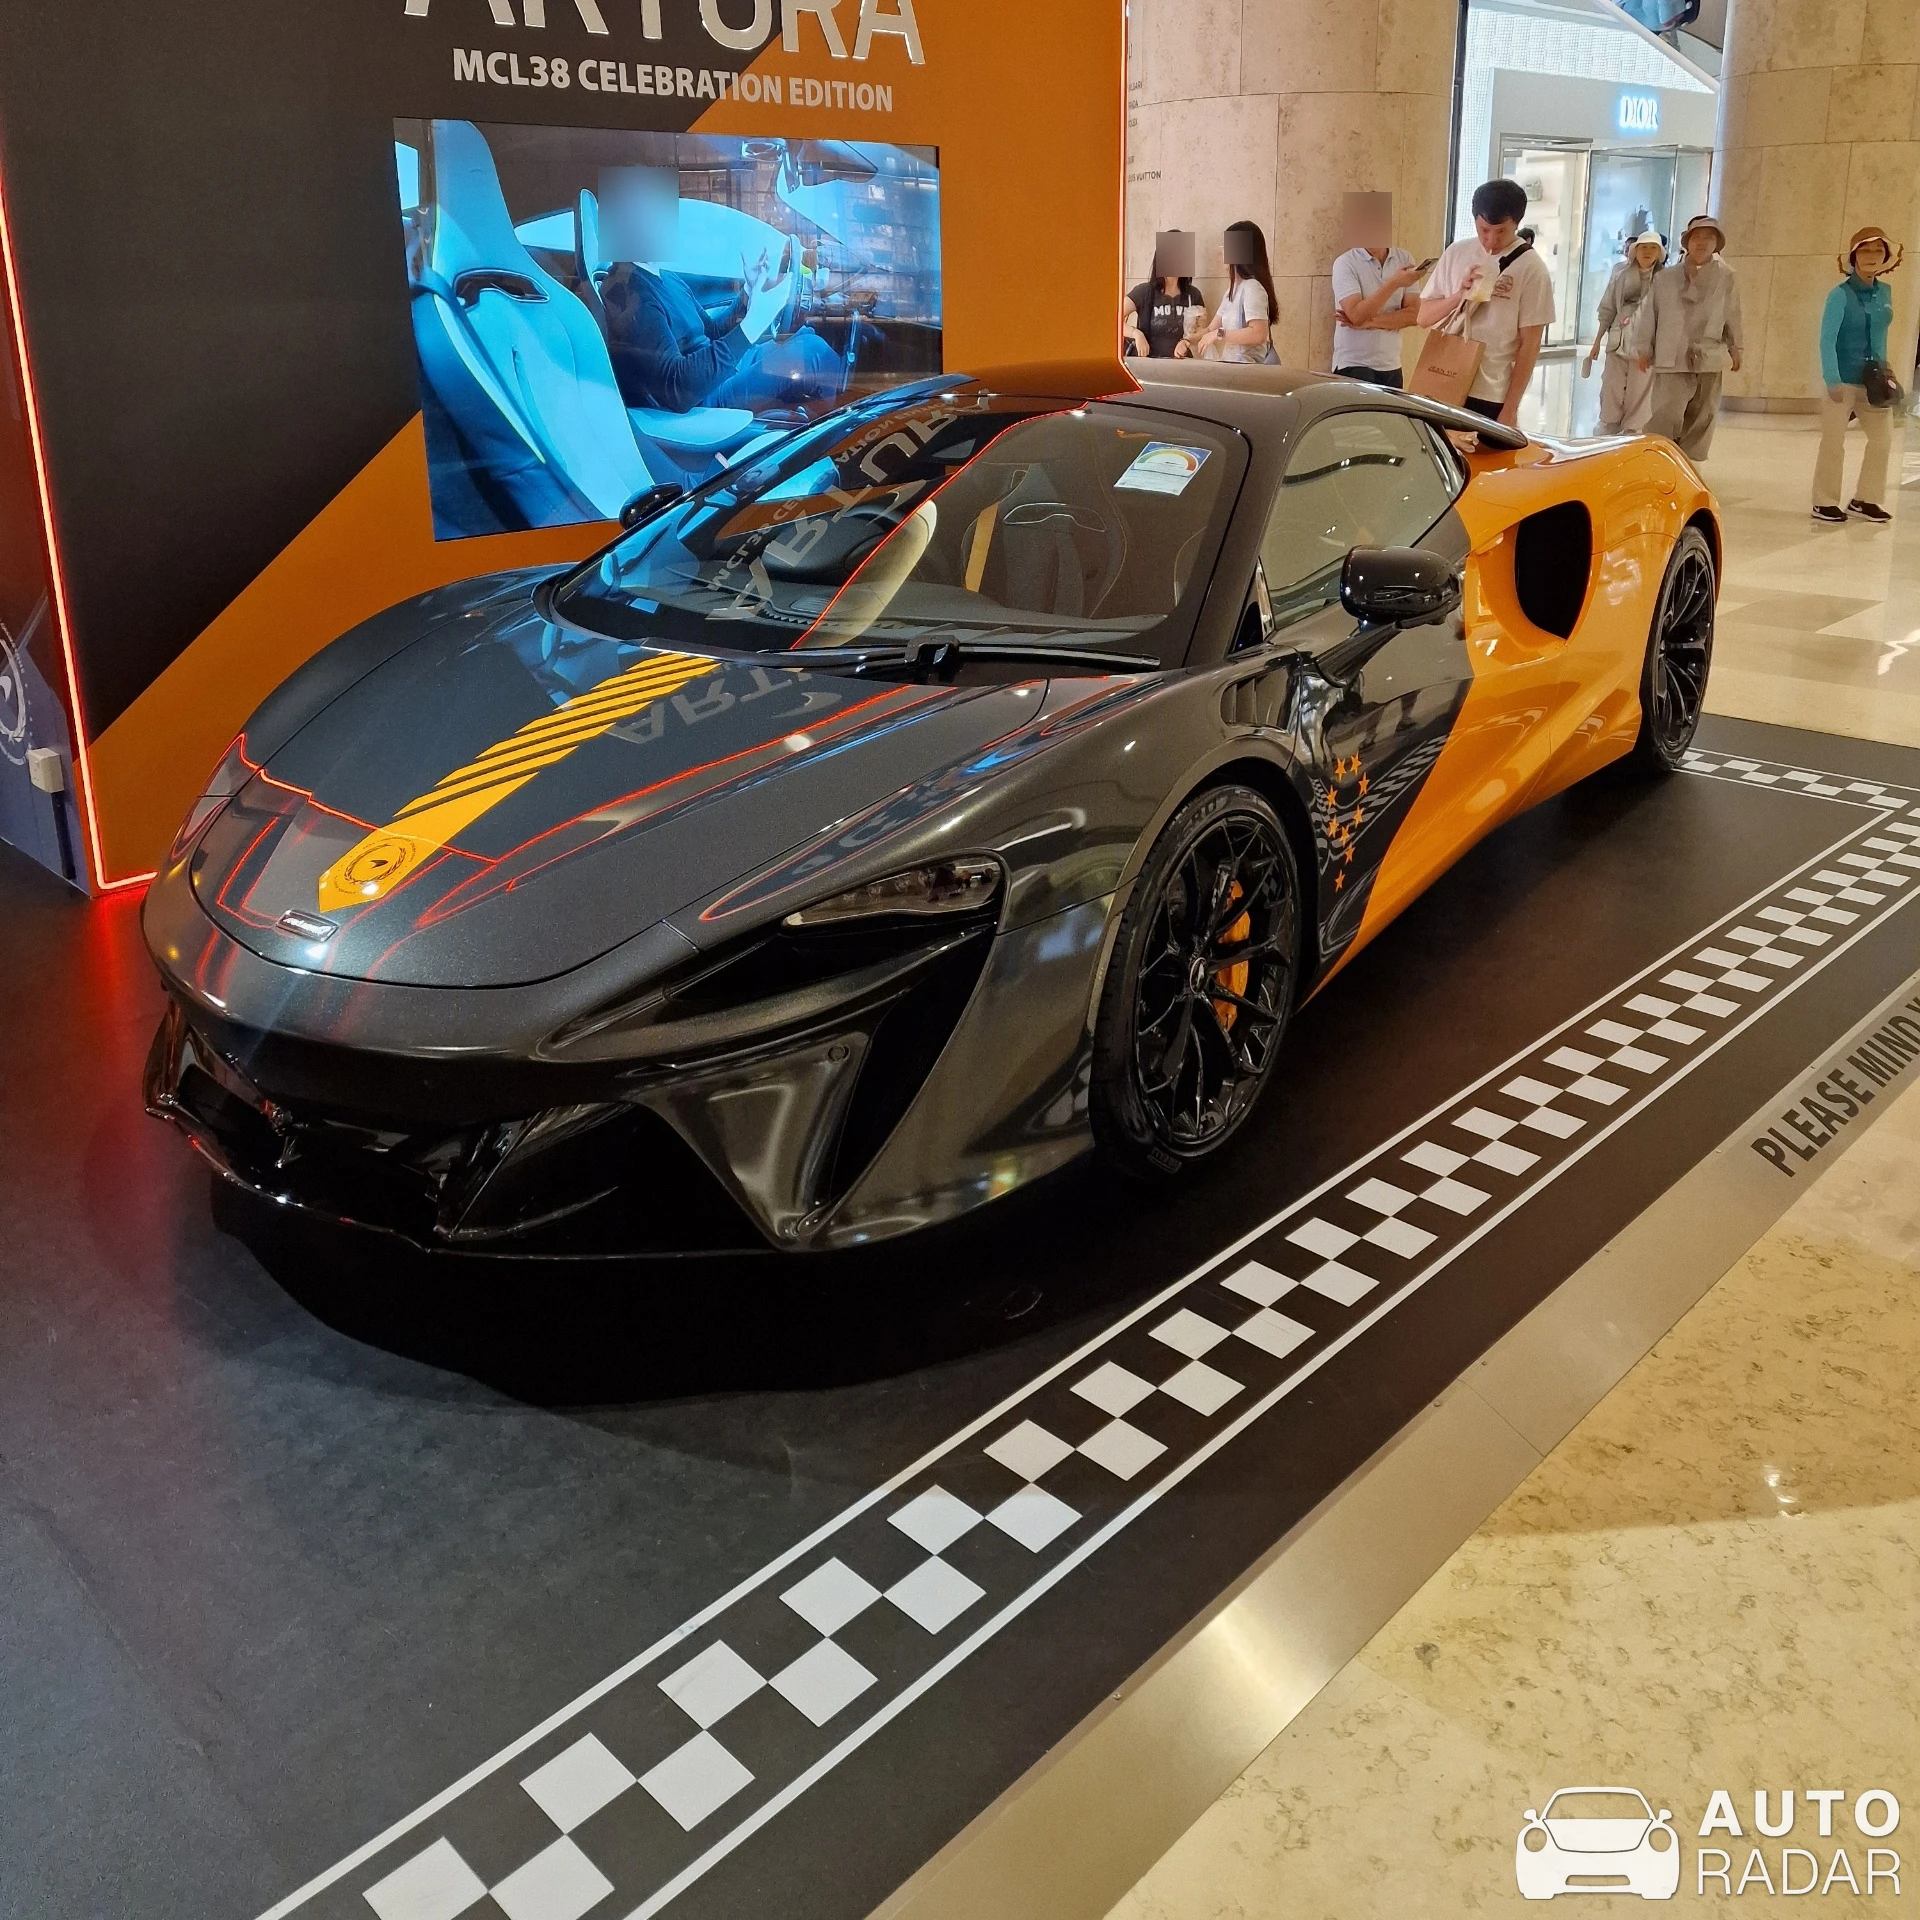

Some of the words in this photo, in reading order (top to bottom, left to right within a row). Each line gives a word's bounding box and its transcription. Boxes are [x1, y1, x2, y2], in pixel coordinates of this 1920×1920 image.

[453, 47, 571, 89] MCL38
[578, 59, 782, 105] CELEBRATION
[789, 77, 893, 112] EDITION
[1620, 96, 1659, 129] DIOR
[1750, 1068, 1876, 1178] PLEASE
[1846, 1015, 1920, 1088] MIND
